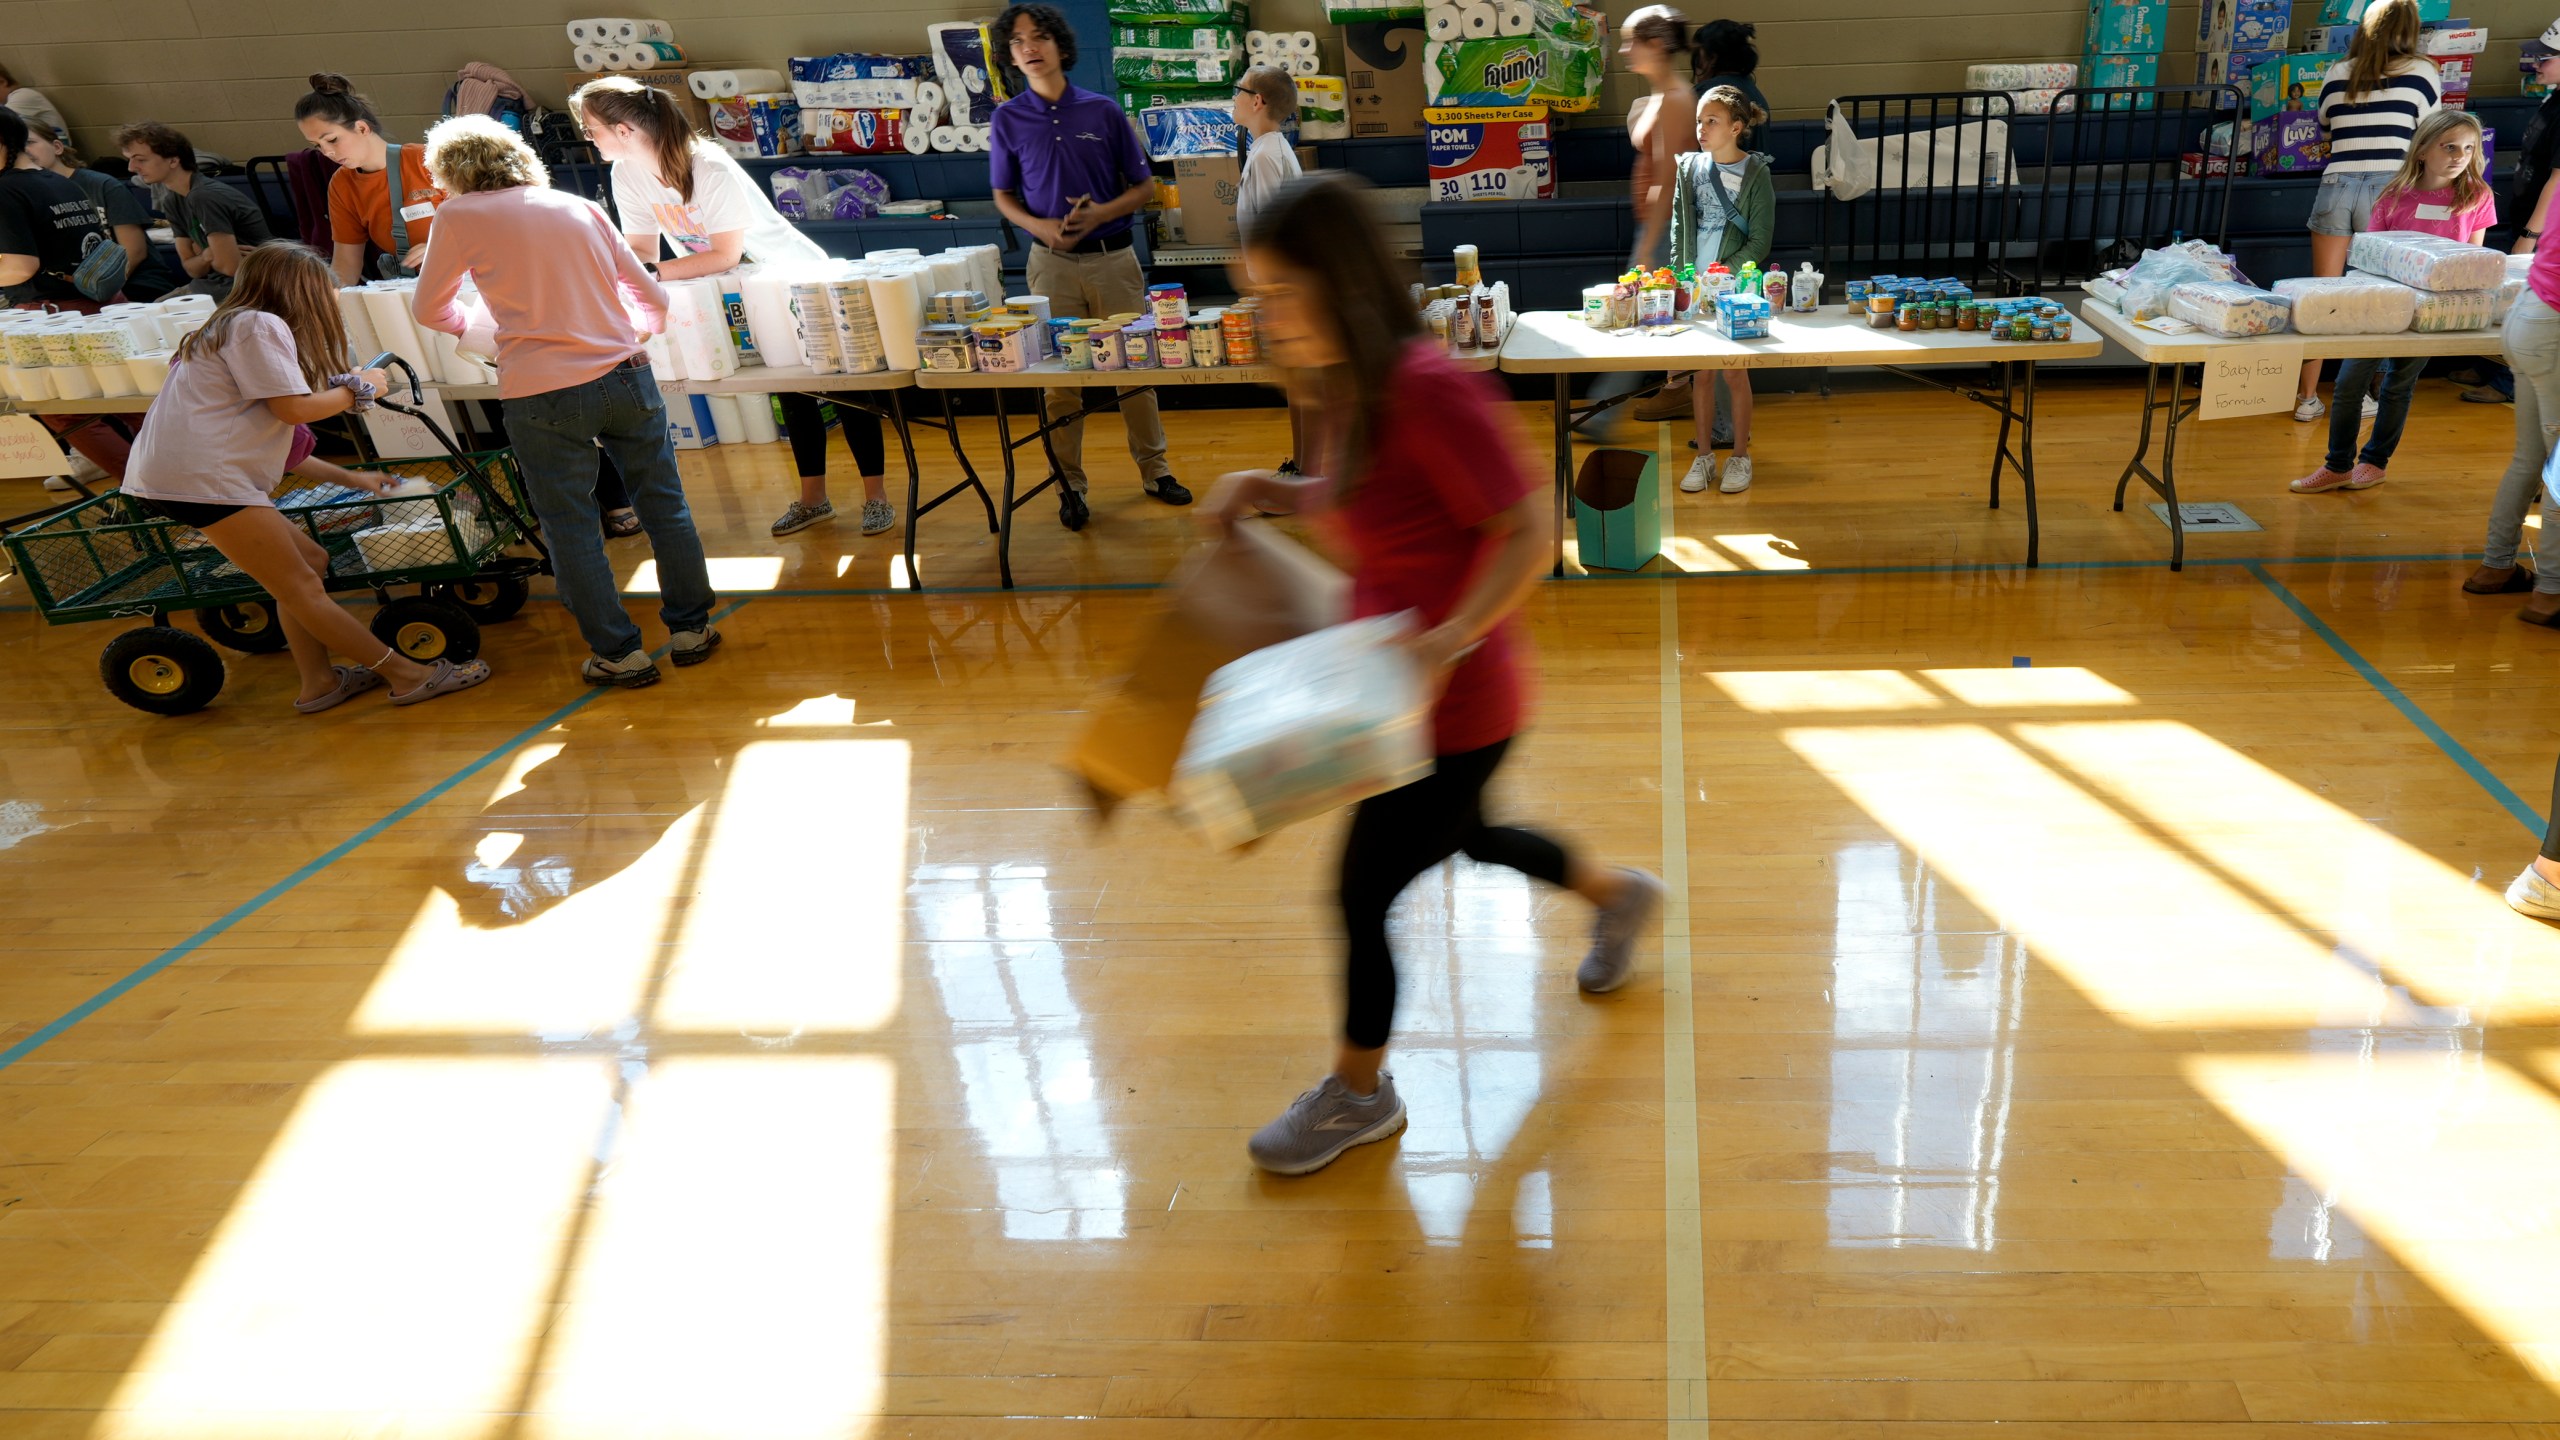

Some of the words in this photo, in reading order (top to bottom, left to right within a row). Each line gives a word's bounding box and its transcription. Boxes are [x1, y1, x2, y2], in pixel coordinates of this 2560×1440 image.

[2134, 6, 2150, 44] Pampers
[2449, 31, 2477, 40] HUGGIES
[1484, 51, 1548, 89] Bounty
[2298, 67, 2327, 80] Pampe
[1561, 99, 1573, 109] 30
[2442, 102, 2465, 110] HUGG
[1437, 112, 1462, 122] 3,300
[1465, 110, 1494, 119] Sheets
[1496, 110, 1511, 118] Per
[1512, 110, 1533, 118] Case
[1430, 128, 1468, 144] POM
[2194, 161, 2248, 175] HUGGES
[1440, 180, 1460, 196] 30
[1470, 172, 1507, 192] 110
[1721, 356, 1766, 367] WHS
[1782, 355, 1834, 367] HOSA
[2217, 360, 2252, 381] Baby
[2257, 359, 2283, 376] Food
[661, 383, 687, 393] OSA
[2216, 393, 2267, 409] Formula
[401, 426, 428, 436] please
